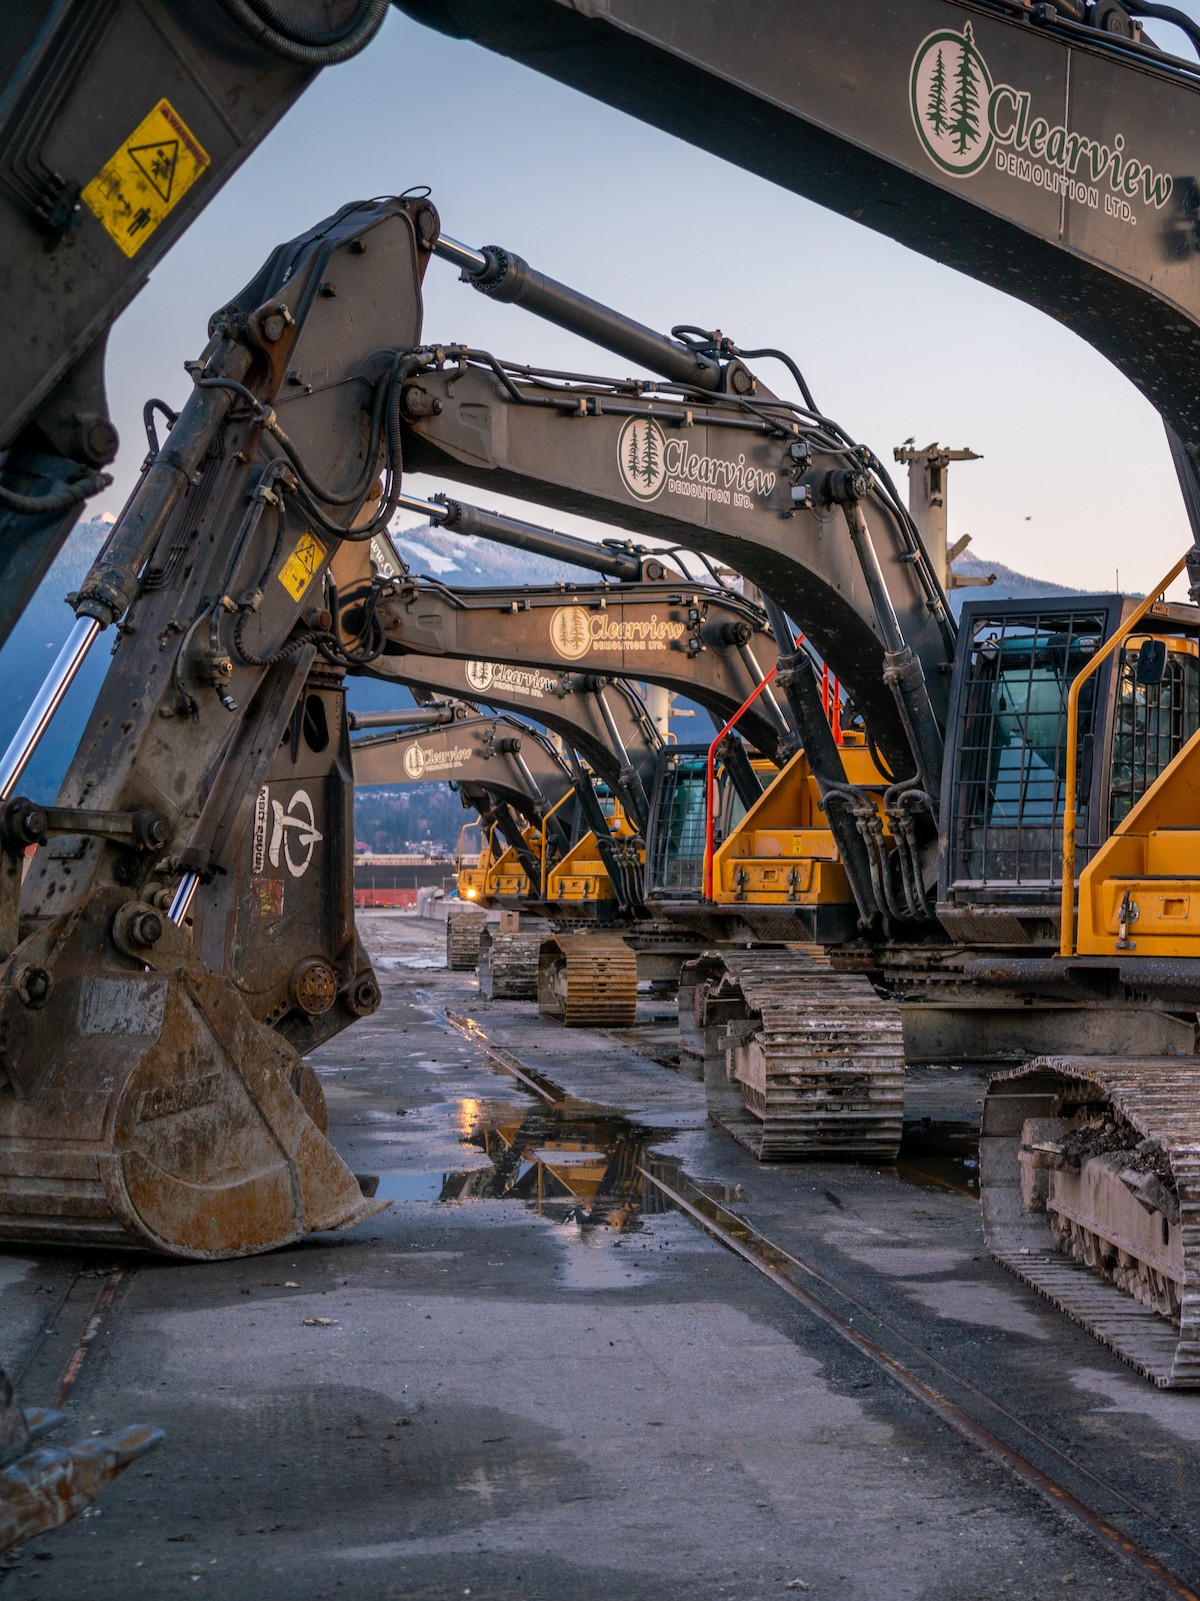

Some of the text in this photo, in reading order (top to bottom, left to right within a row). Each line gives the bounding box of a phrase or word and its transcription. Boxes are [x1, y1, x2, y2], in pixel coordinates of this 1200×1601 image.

[987, 83, 1173, 210] Clearview
[996, 148, 1138, 225] DEMOLITION LTD.
[663, 438, 776, 497] Clearview
[668, 478, 755, 510] DEMOLITION LTD.
[588, 614, 685, 640] Clearview
[592, 640, 667, 651] DEMOLITION LTD.
[492, 663, 558, 692] Clearview
[423, 745, 473, 766] Clearview
